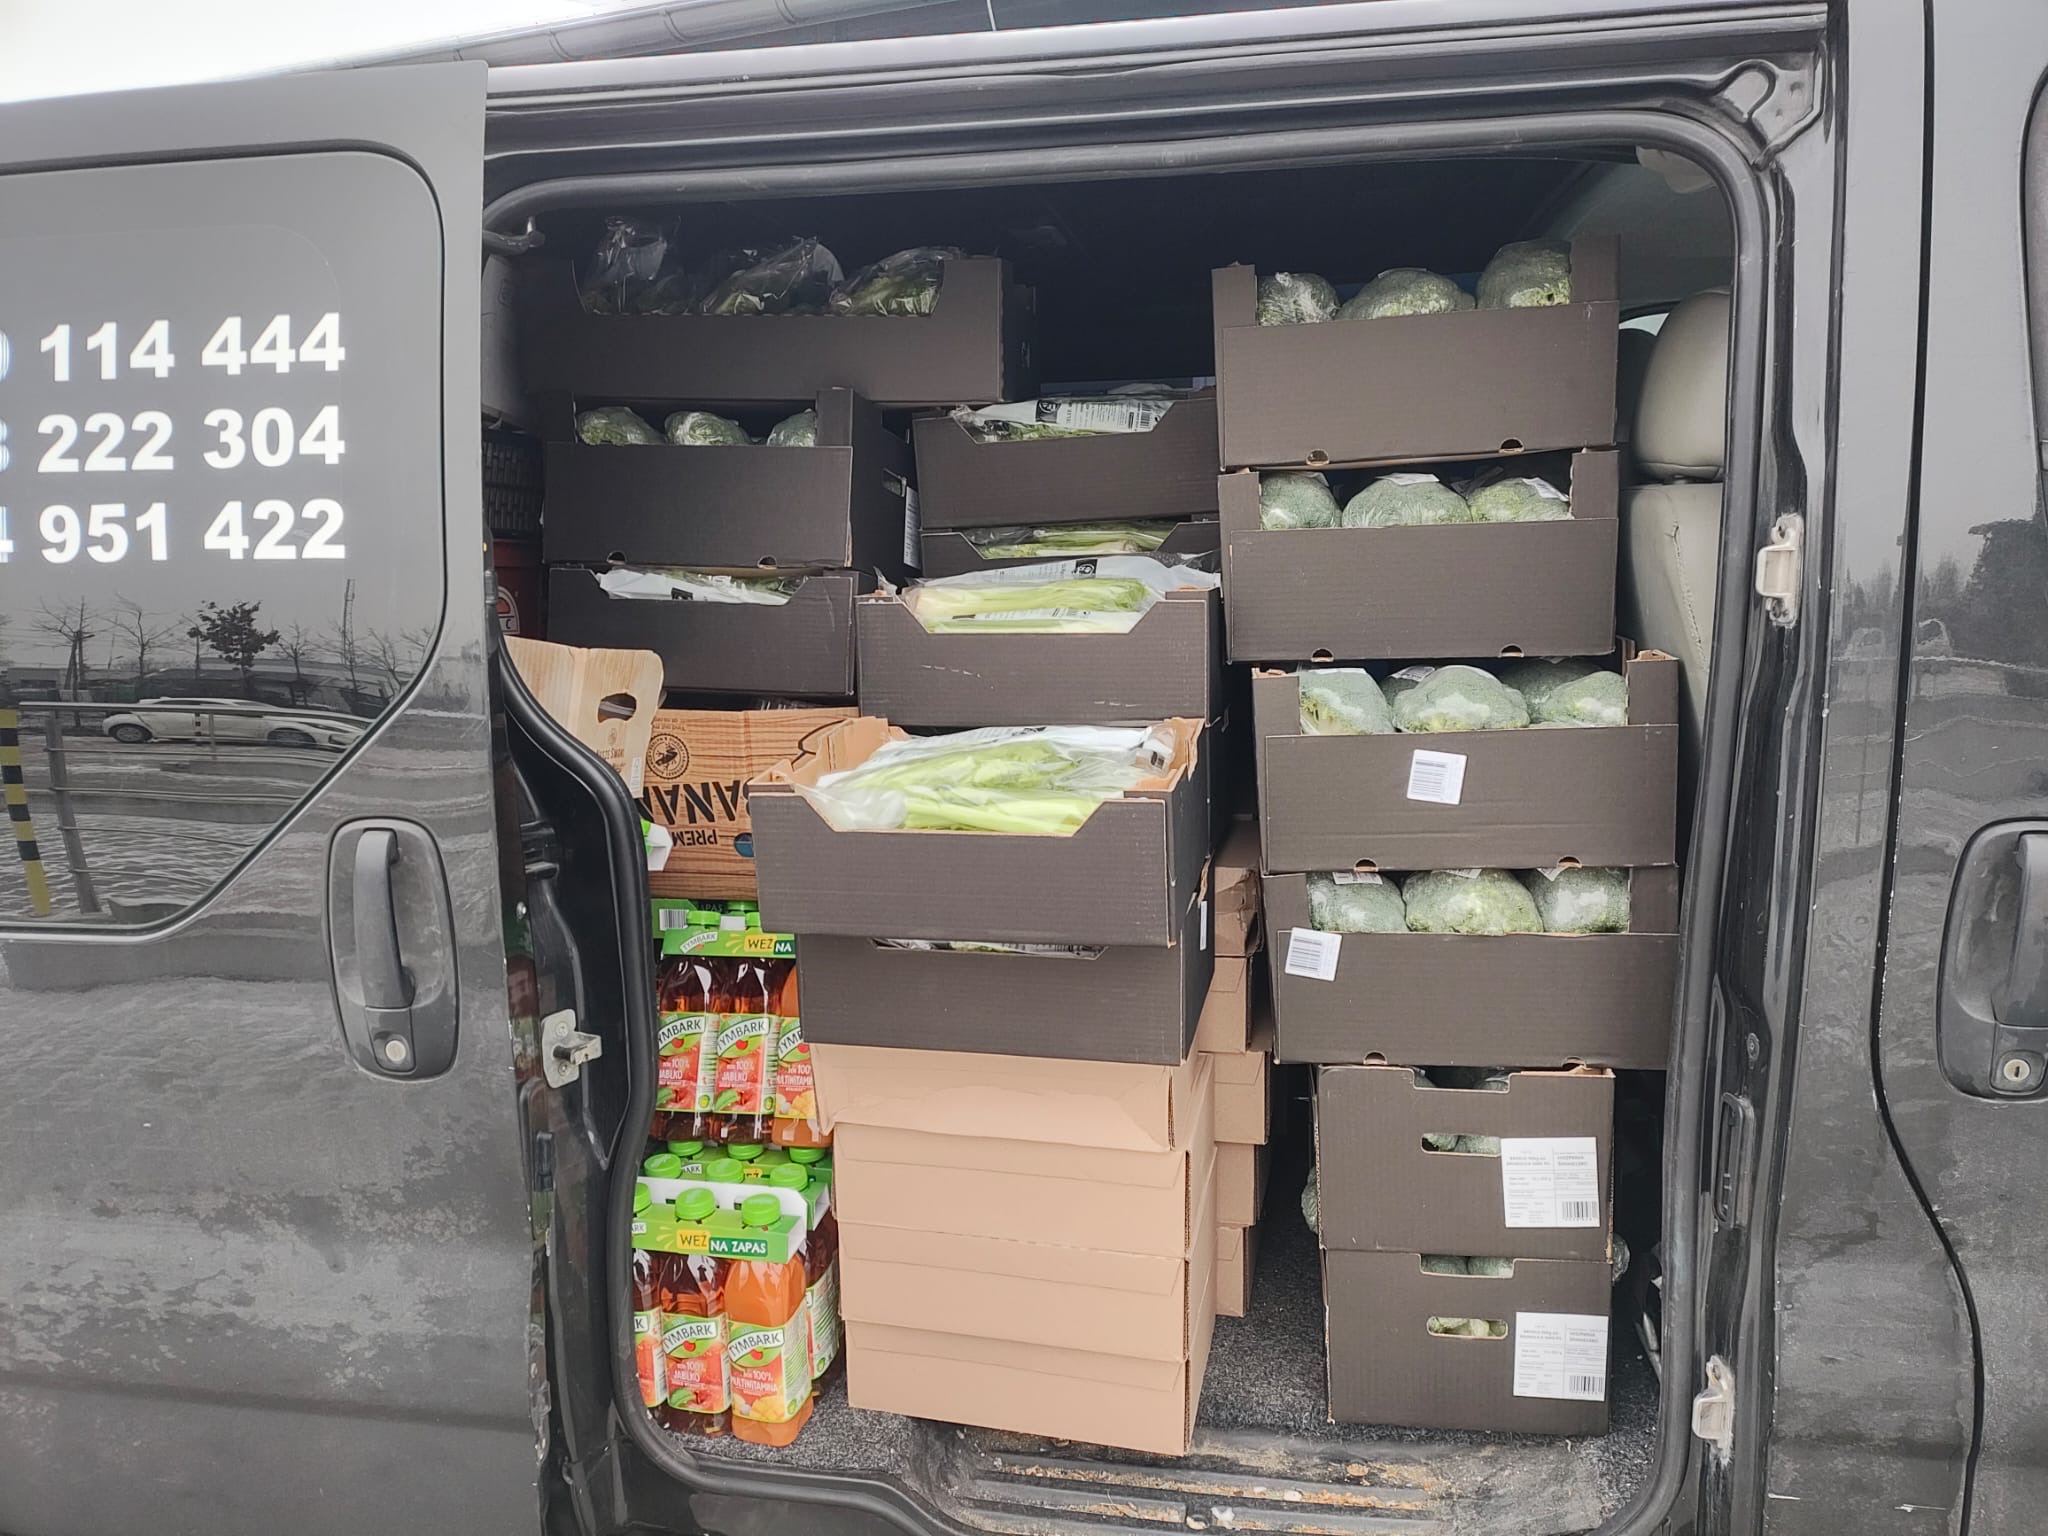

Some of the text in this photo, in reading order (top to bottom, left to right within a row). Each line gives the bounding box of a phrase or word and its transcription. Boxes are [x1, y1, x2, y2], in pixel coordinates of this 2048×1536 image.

[40, 319, 175, 382] 114
[201, 312, 346, 375] 444
[37, 411, 174, 473] 222
[203, 405, 346, 469] 304
[38, 502, 168, 564] 951
[203, 498, 346, 560] 422
[636, 777, 753, 826] ANA
[775, 942, 792, 953] NA
[658, 1019, 702, 1045] YMBARK
[718, 1020, 765, 1051] TYMBARK
[710, 1241, 728, 1252] NA
[731, 1242, 767, 1254] ZAPAS
[664, 1324, 713, 1350] TYMBARK
[729, 1332, 781, 1358] TYMBARK
